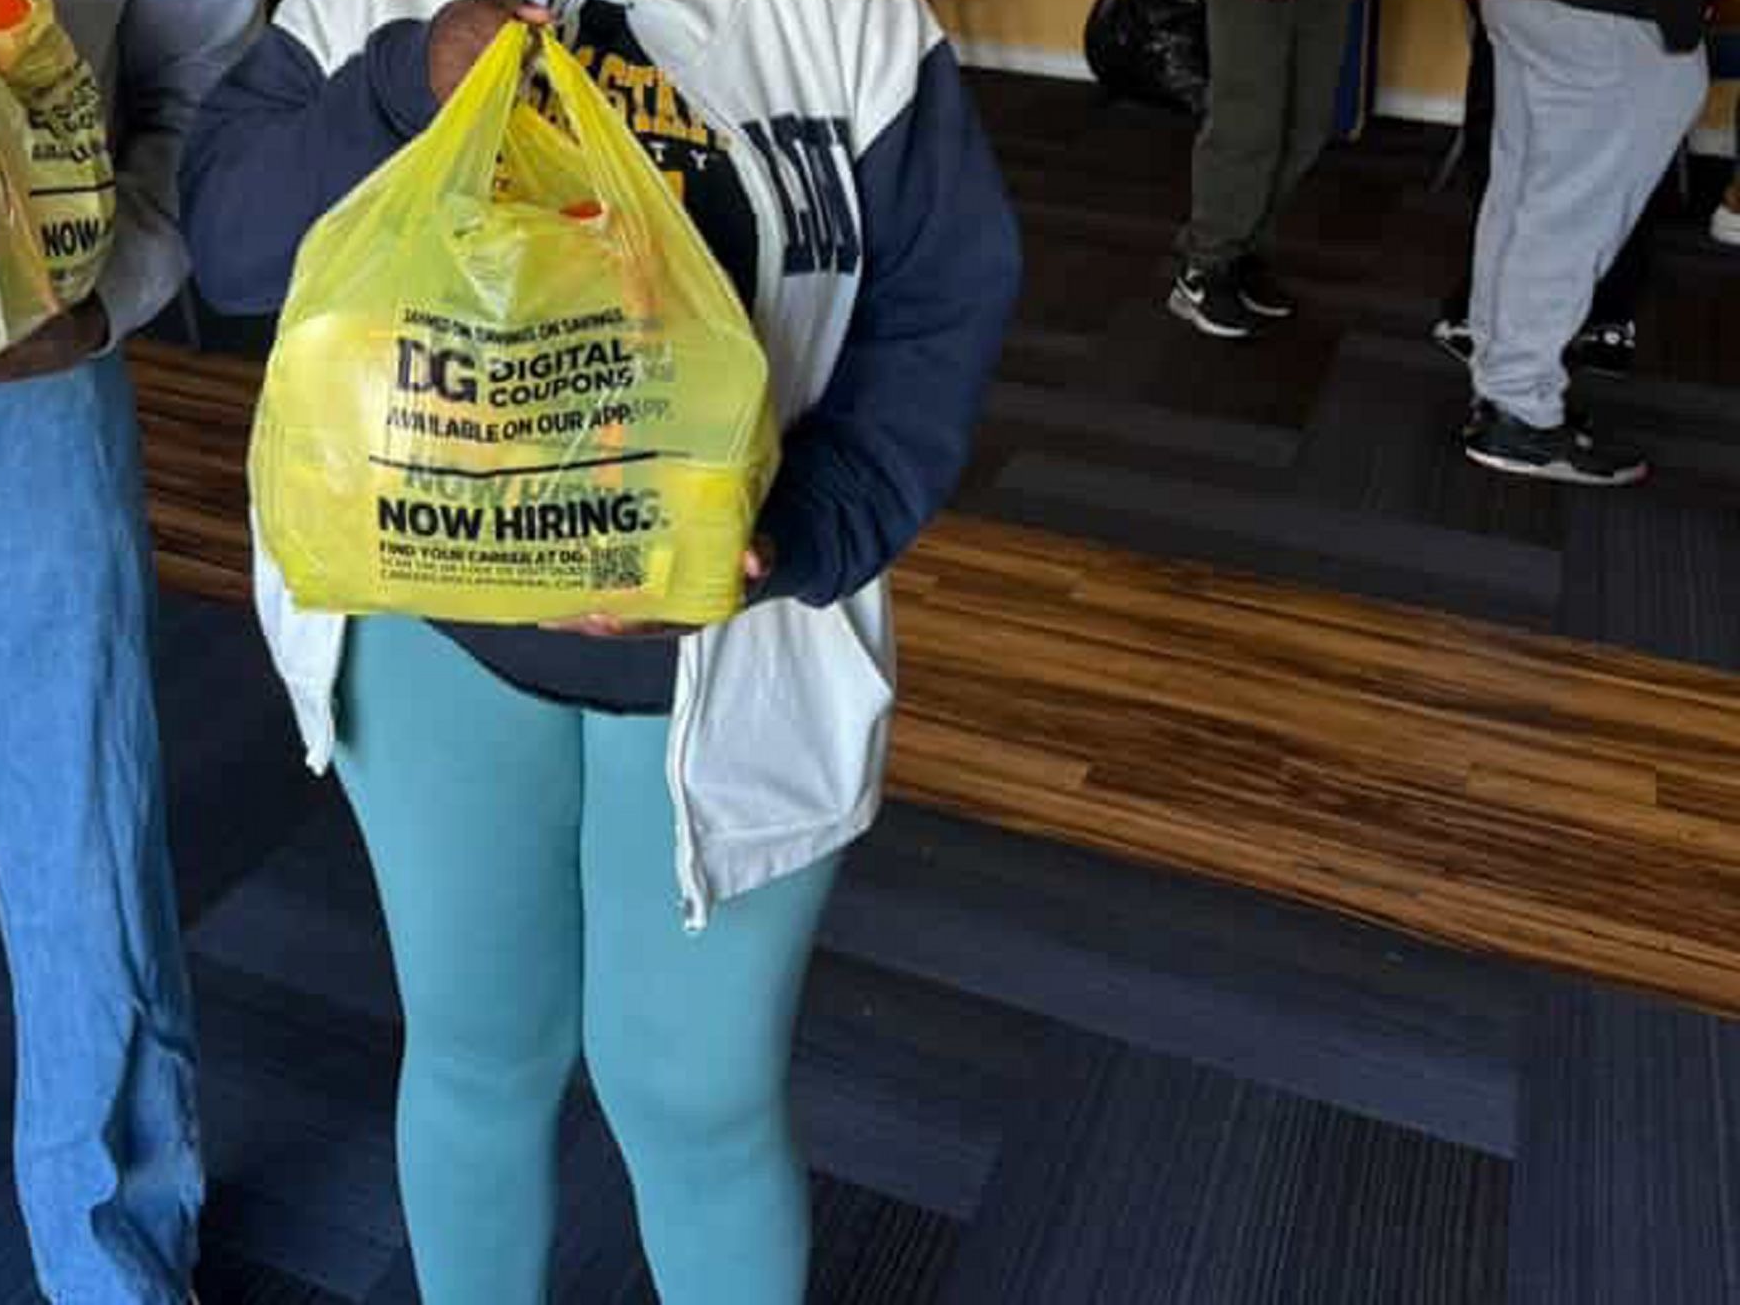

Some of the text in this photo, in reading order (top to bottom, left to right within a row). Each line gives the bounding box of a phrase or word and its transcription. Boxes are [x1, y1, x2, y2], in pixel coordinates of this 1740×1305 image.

[42, 219, 100, 257] NOW
[396, 337, 477, 405] DG
[489, 338, 633, 384] DIGITAL
[489, 365, 634, 408] COUPONS
[385, 406, 499, 444] AVAILABLE
[502, 419, 533, 442] ON
[536, 411, 583, 435] OUR
[377, 494, 651, 543] NOW HIRING.
[535, 551, 556, 564] AT
